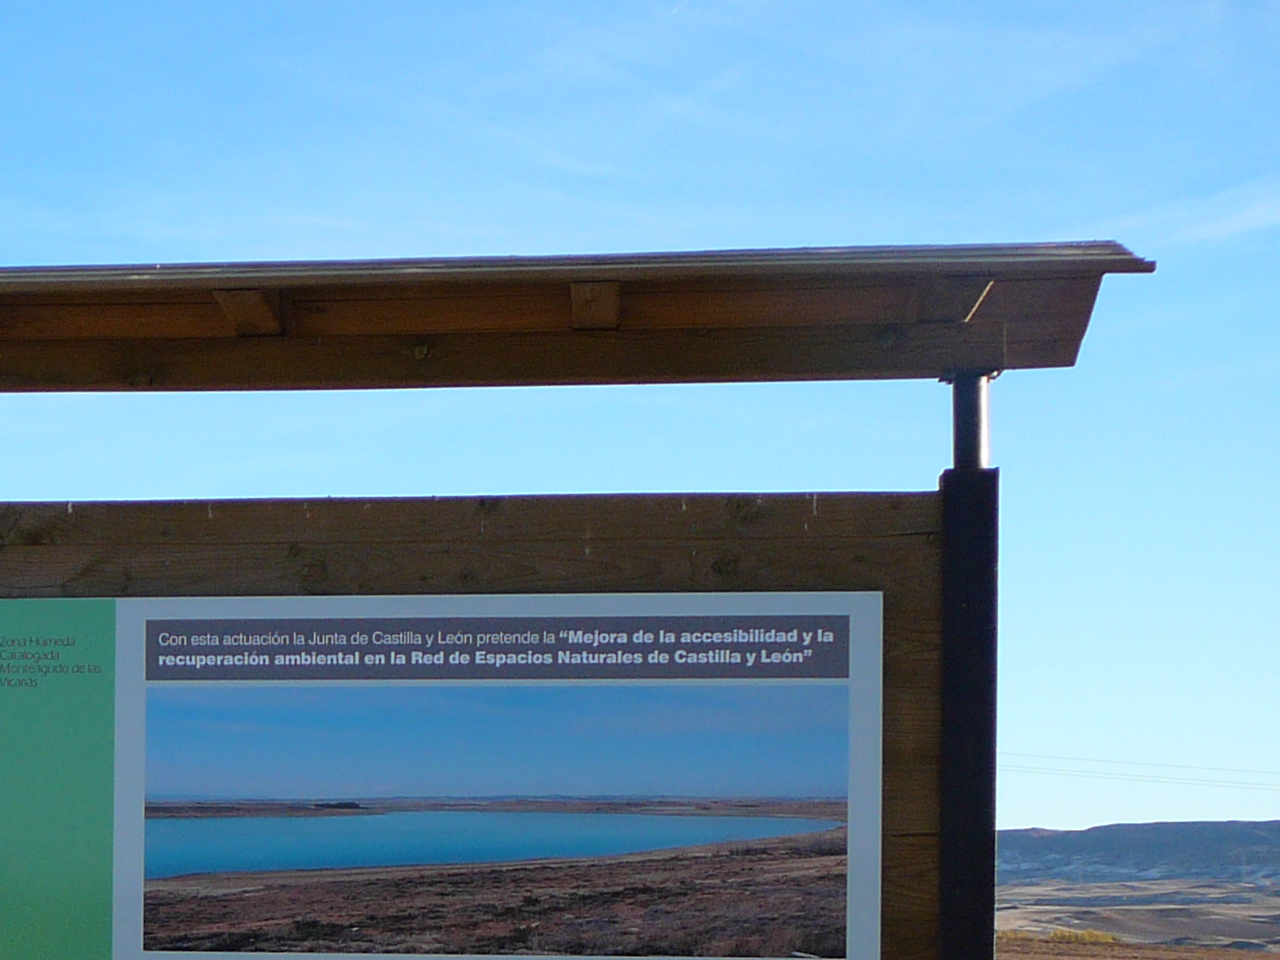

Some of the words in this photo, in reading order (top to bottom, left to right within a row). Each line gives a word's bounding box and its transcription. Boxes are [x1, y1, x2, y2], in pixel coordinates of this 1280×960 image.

[158, 632, 187, 646] Con
[191, 634, 219, 645] esta
[223, 632, 289, 645] actuación
[293, 632, 305, 645] la
[308, 631, 347, 645] Junta
[351, 631, 368, 645] de
[372, 631, 421, 645] Castilla
[425, 634, 434, 647] y
[438, 631, 472, 645] León
[476, 630, 539, 648] pretende
[543, 631, 556, 644] la
[633, 630, 654, 643] de
[659, 630, 675, 643] la
[680, 629, 797, 643] accesibilidad
[802, 632, 812, 645] y
[817, 629, 834, 642] la
[158, 651, 270, 668] recuperación
[274, 651, 359, 665] ambiental
[364, 654, 386, 665] en
[390, 651, 406, 665] la
[411, 651, 444, 665] Red
[448, 651, 470, 665] de
[475, 650, 552, 668] Espacios
[557, 651, 643, 664] Naturales
[647, 650, 669, 664] de
[674, 650, 741, 664] Castilla
[746, 653, 756, 667] y
